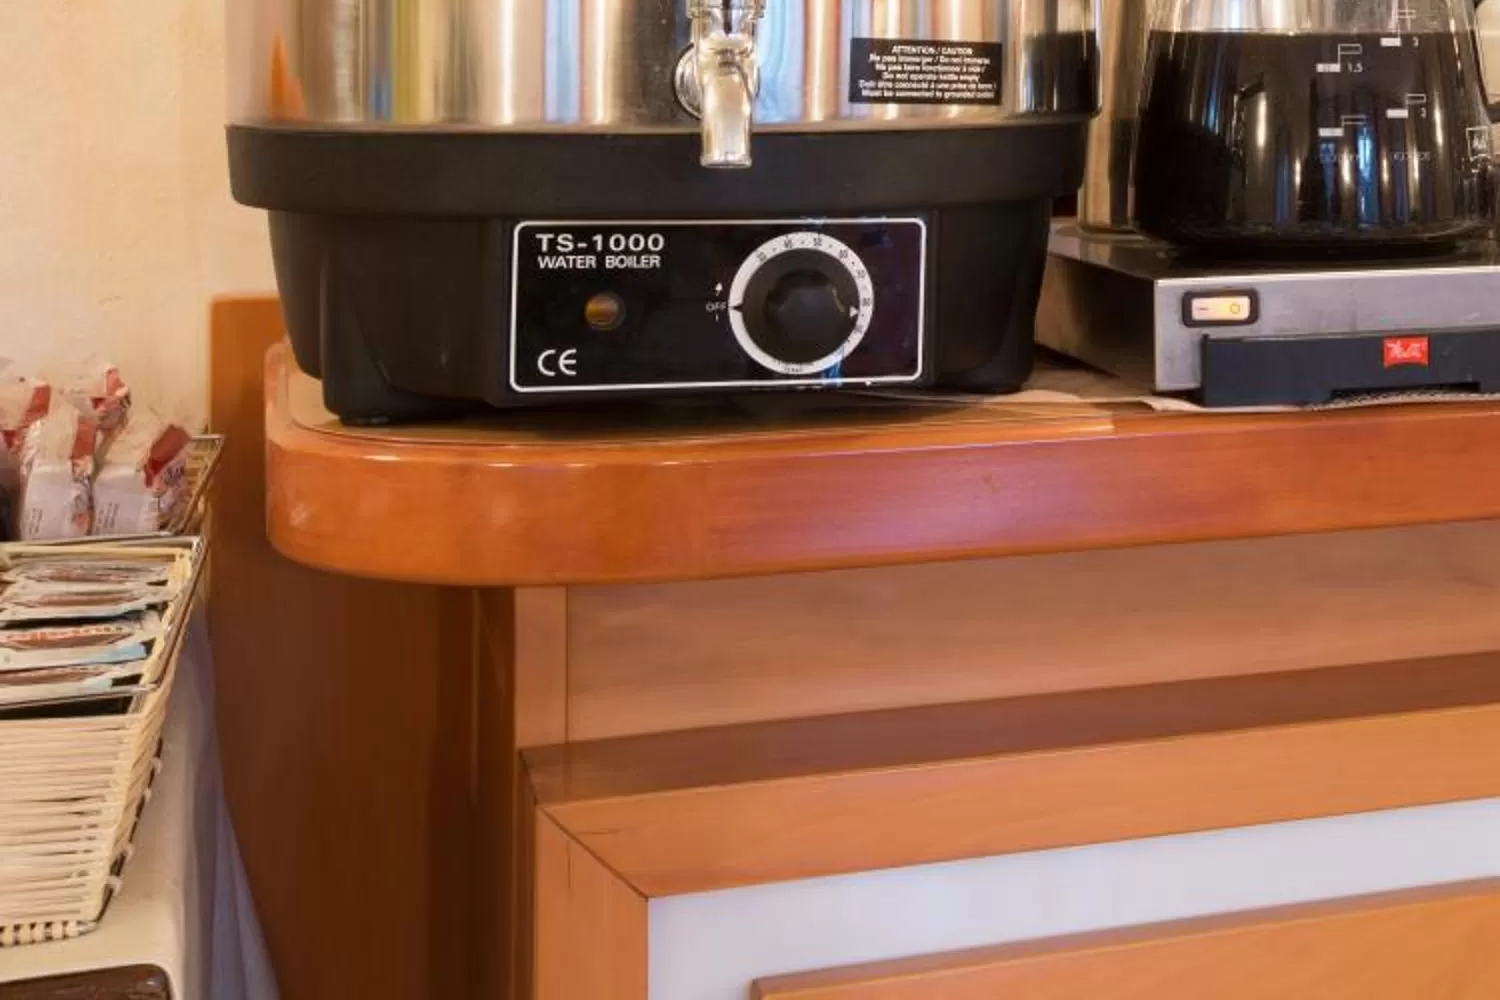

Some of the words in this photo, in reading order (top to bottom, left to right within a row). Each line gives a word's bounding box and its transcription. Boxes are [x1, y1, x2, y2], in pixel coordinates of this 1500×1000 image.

[535, 233, 665, 252] TS-1000
[537, 255, 597, 269] WATER
[604, 255, 661, 269] BOILER
[705, 300, 728, 312] OFF
[537, 348, 577, 377] CE
